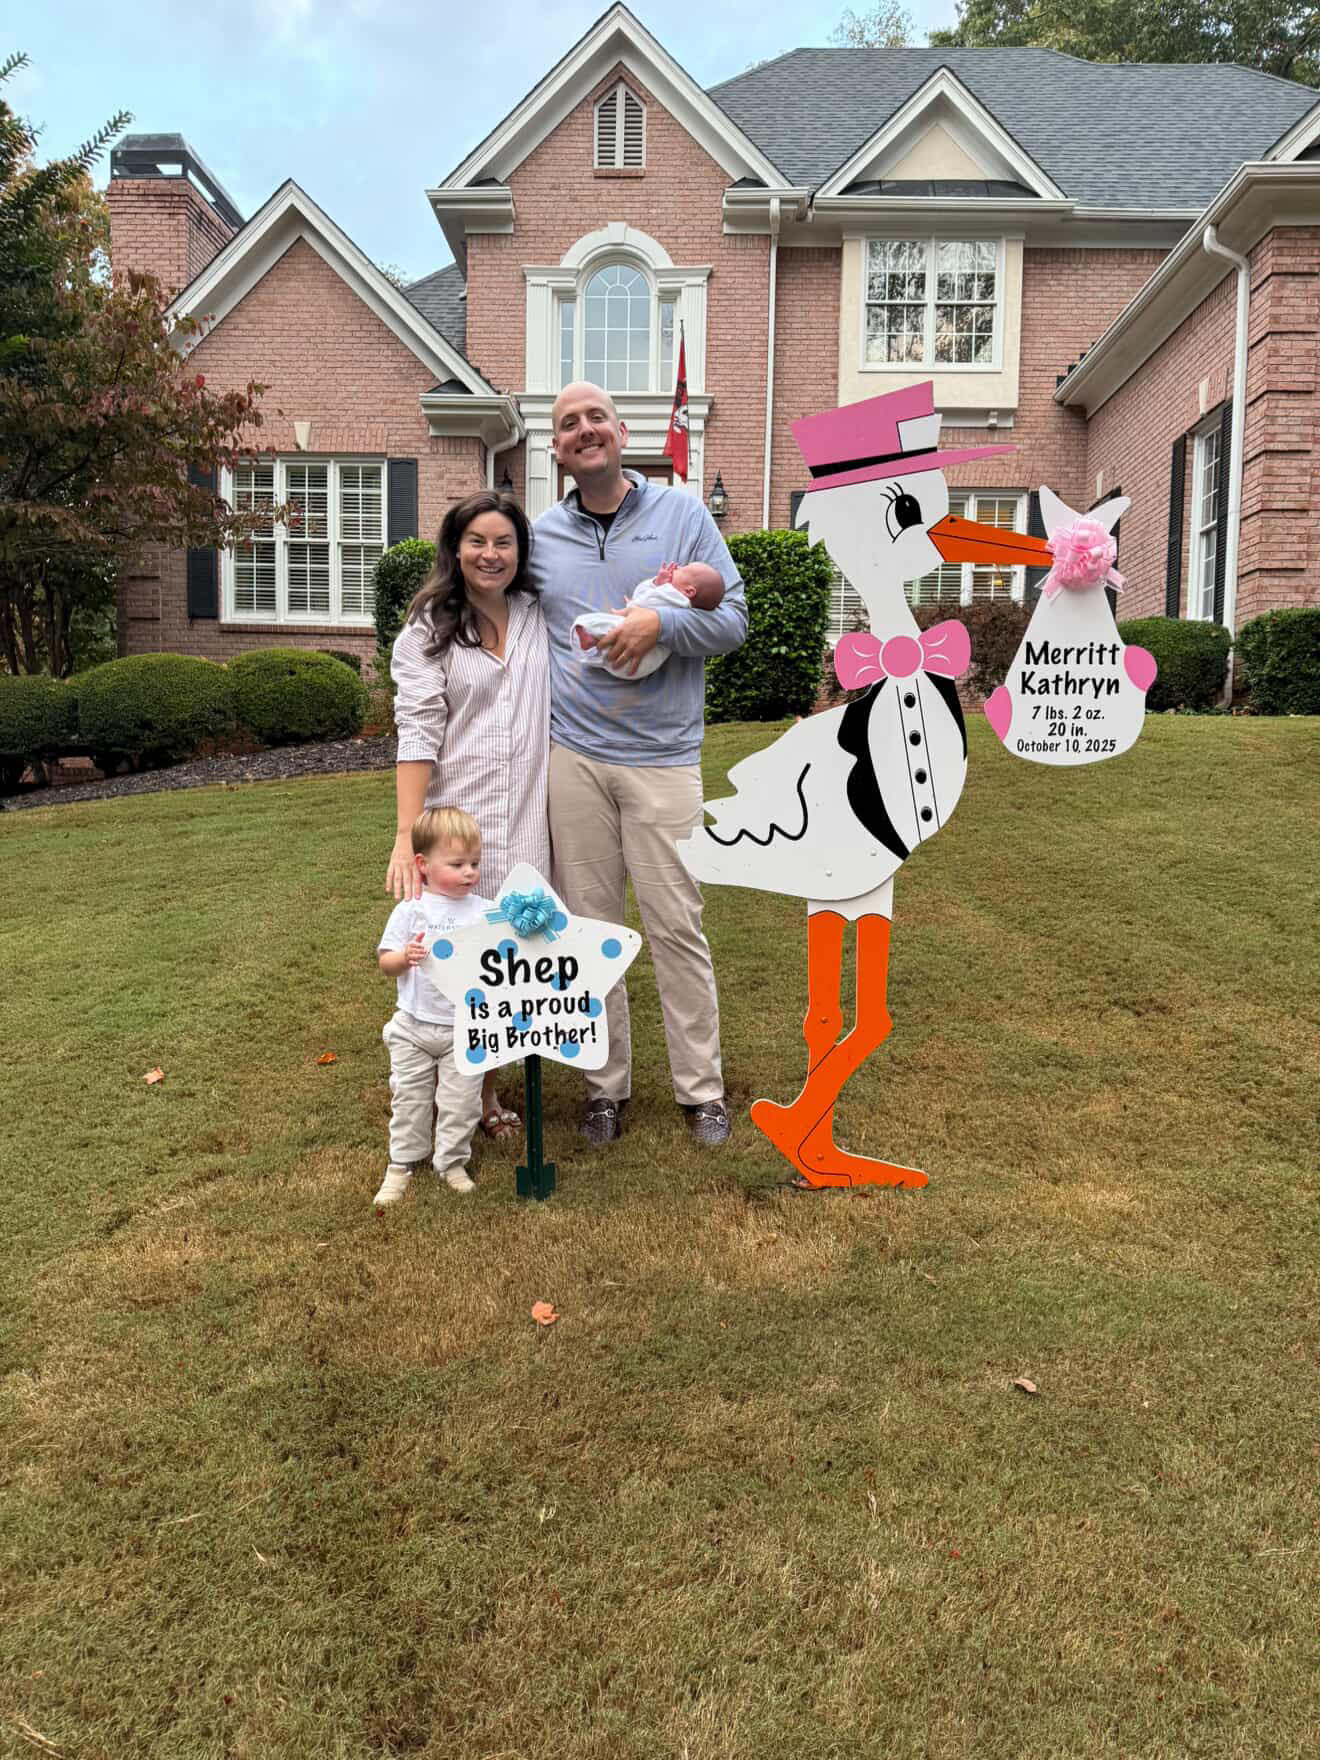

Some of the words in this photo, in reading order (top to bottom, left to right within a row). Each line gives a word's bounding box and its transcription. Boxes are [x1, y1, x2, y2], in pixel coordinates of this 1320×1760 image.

[1025, 640, 1120, 665] Merritt
[1021, 671, 1119, 699] Kathryn
[1032, 706, 1041, 719] 7
[1046, 706, 1067, 720] lbs.
[1072, 706, 1081, 719] 2
[1086, 710, 1104, 720] oz.
[1048, 722, 1066, 736] 20
[1071, 723, 1087, 736] in.
[1017, 739, 1061, 752] October
[1065, 739, 1081, 754] 10,
[1085, 739, 1116, 752] 2025
[480, 948, 578, 990] Shep
[471, 997, 489, 1019] is
[498, 1001, 512, 1018] a
[521, 990, 590, 1022] proud
[468, 1028, 499, 1053] Big
[506, 1021, 597, 1048] Brother!
